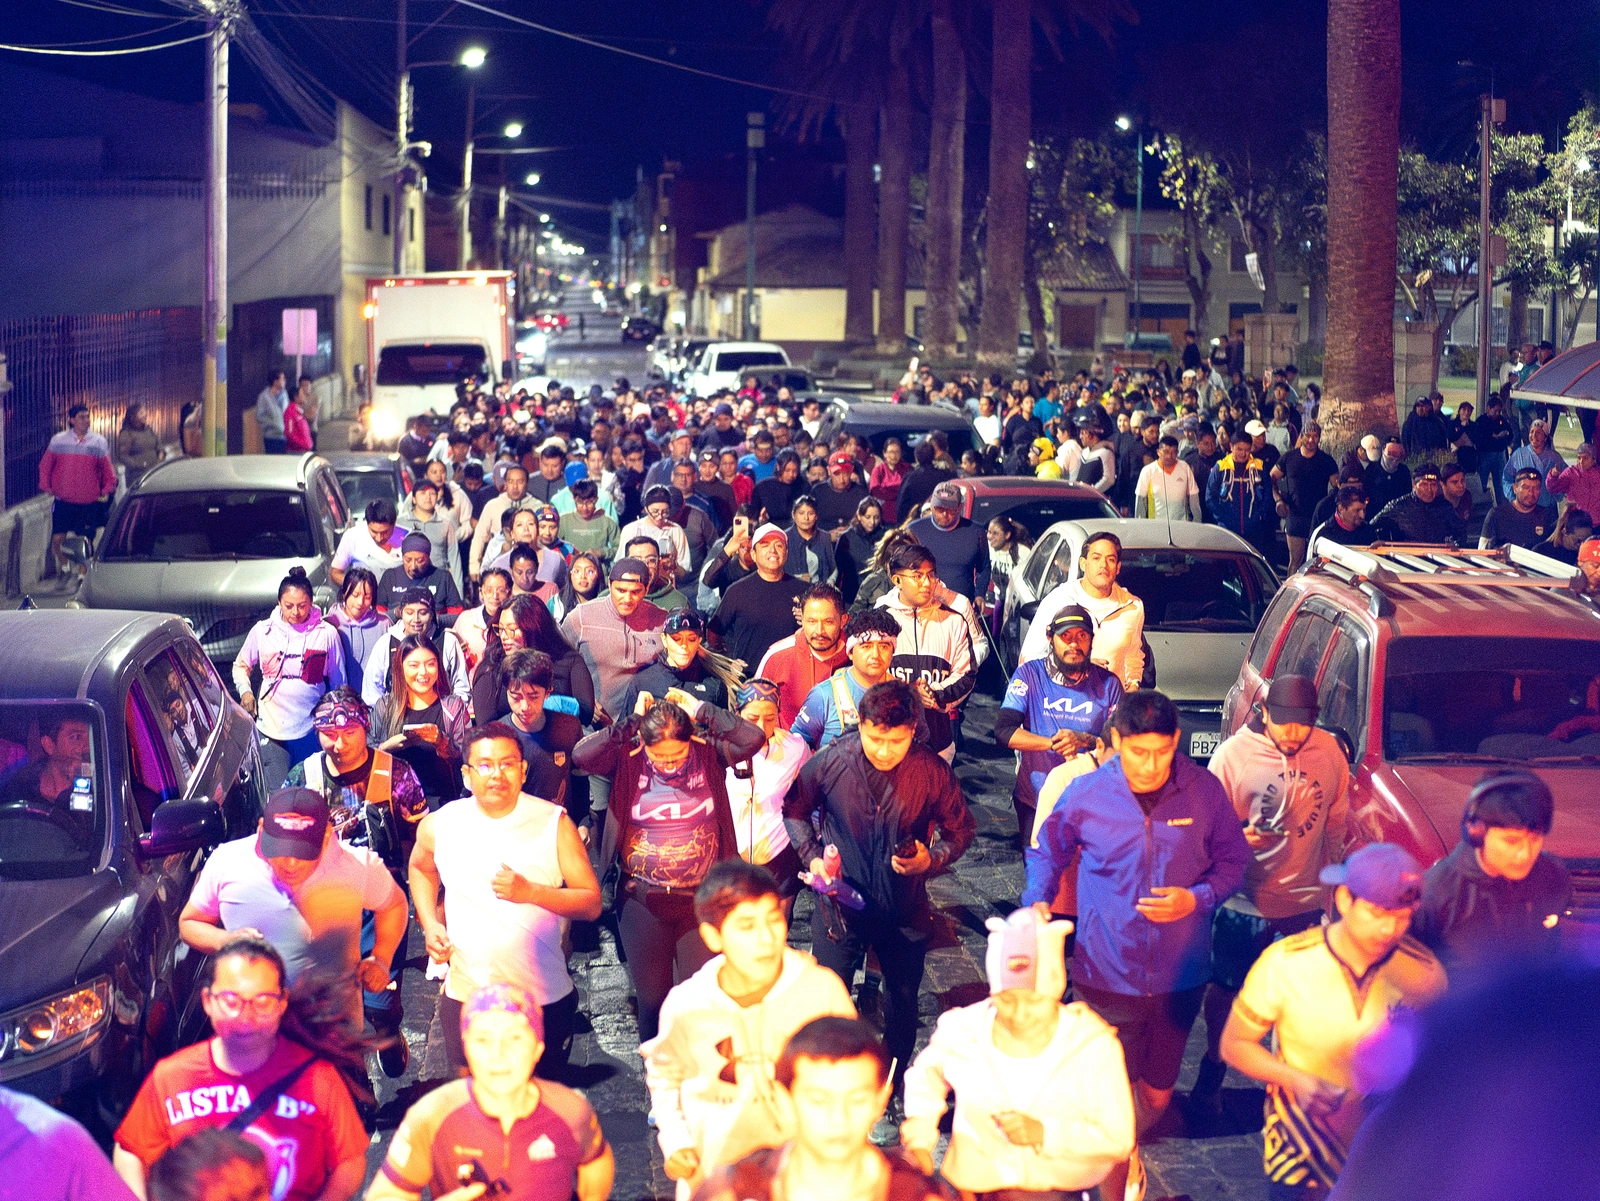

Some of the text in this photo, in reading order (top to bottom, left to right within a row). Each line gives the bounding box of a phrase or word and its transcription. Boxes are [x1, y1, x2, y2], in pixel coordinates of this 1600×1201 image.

[1043, 696, 1093, 714] KIA
[1192, 741, 1218, 754] PBZ
[632, 797, 714, 820] KIA
[1278, 770, 1307, 782] THE
[1297, 780, 1323, 838] FUTURE
[165, 1084, 252, 1126] LISTA
